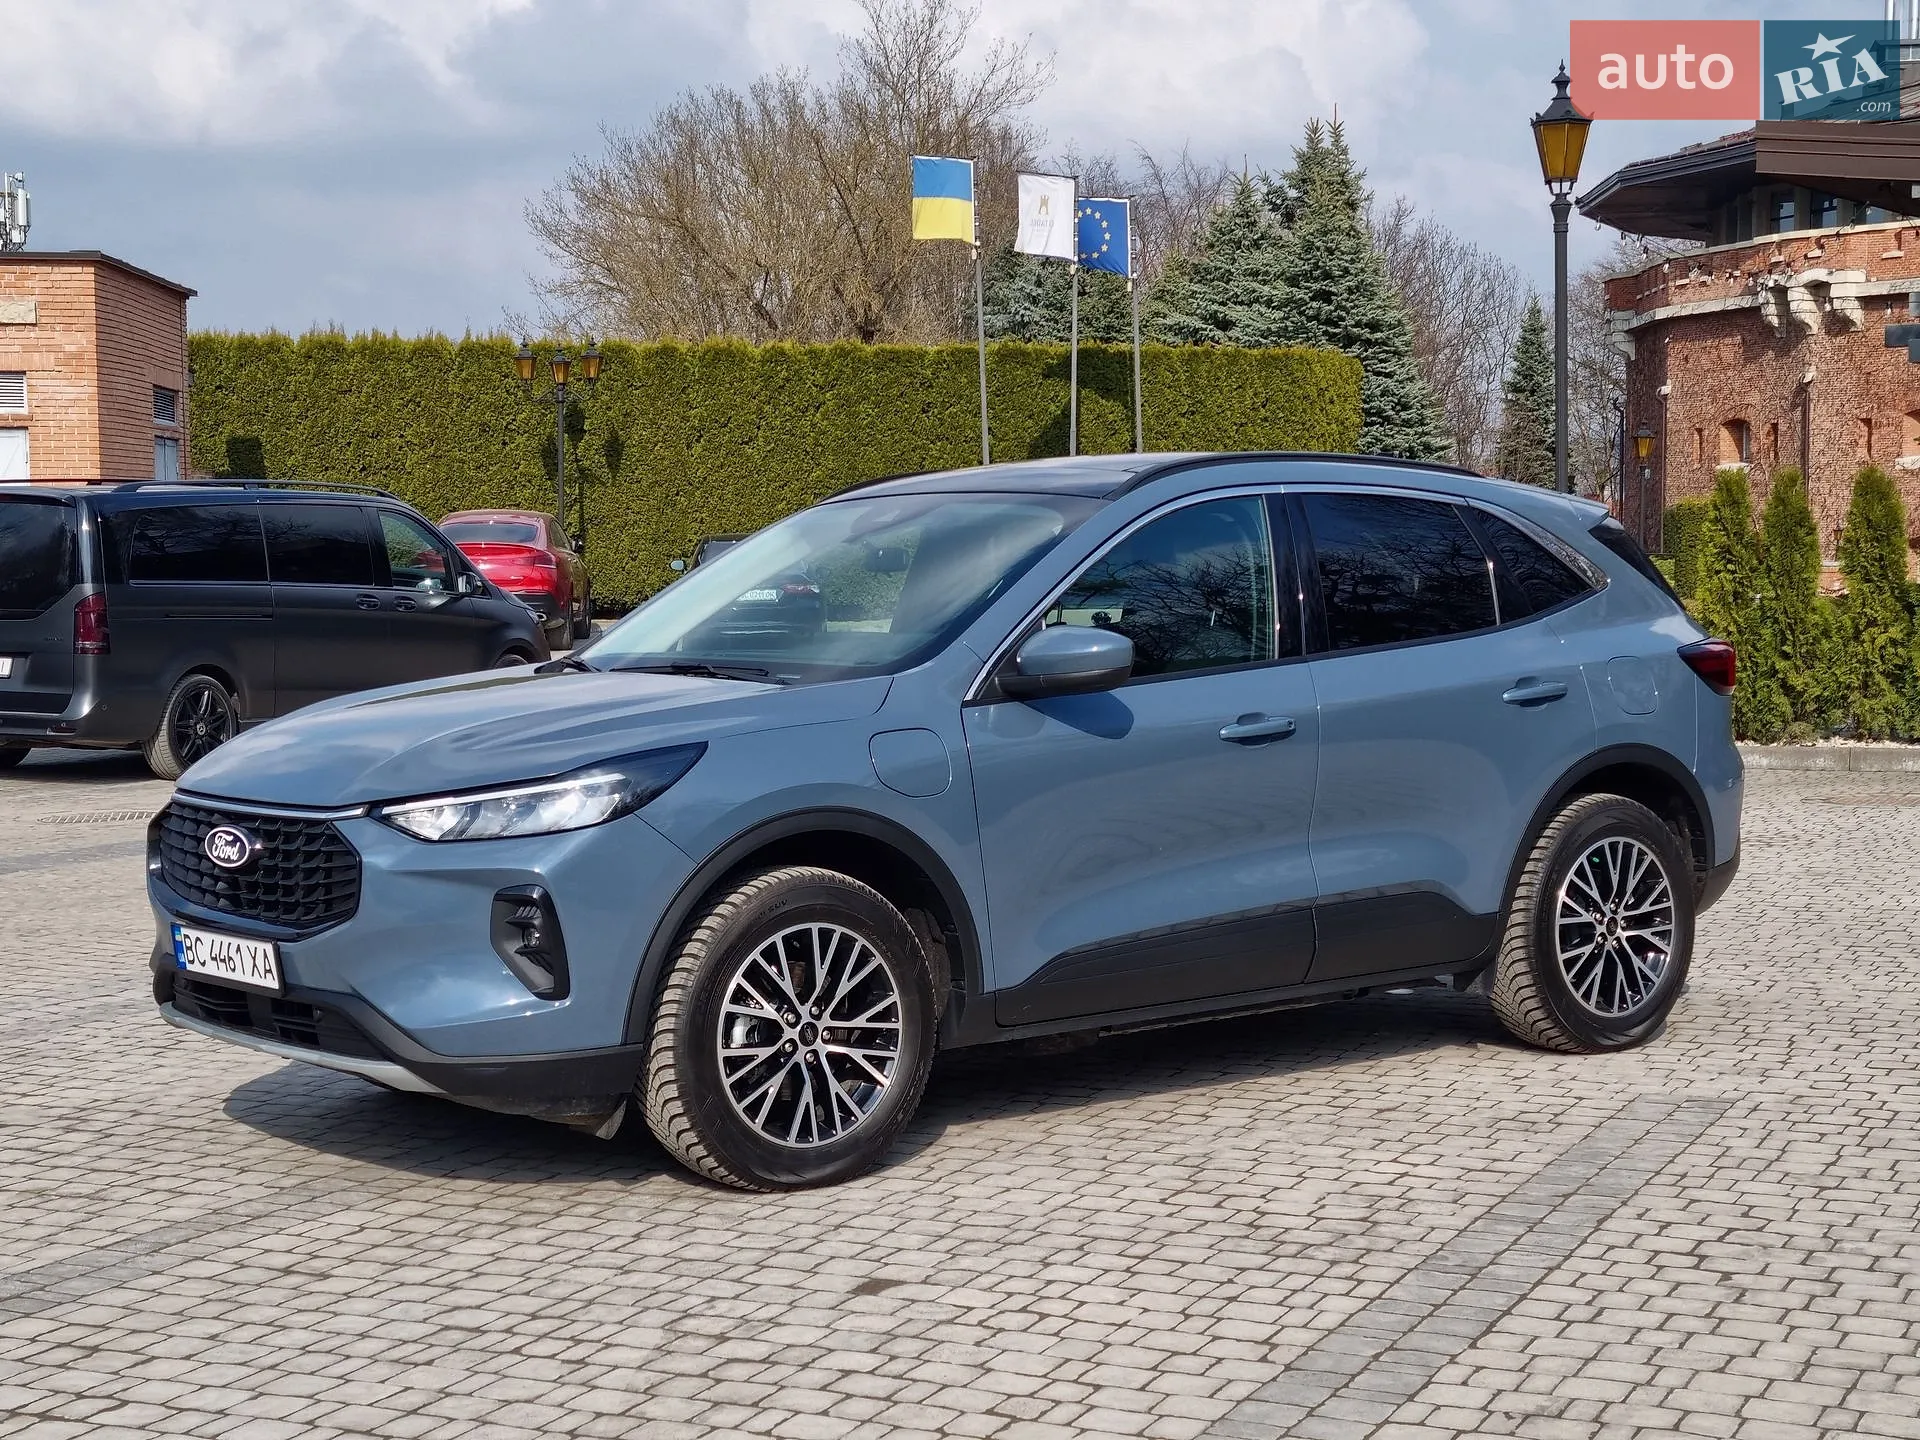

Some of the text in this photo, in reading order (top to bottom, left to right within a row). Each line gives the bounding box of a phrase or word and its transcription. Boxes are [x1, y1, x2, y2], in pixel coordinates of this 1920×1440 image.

[211, 832, 241, 862] Ford
[183, 933, 276, 981] BC 4461 XA
